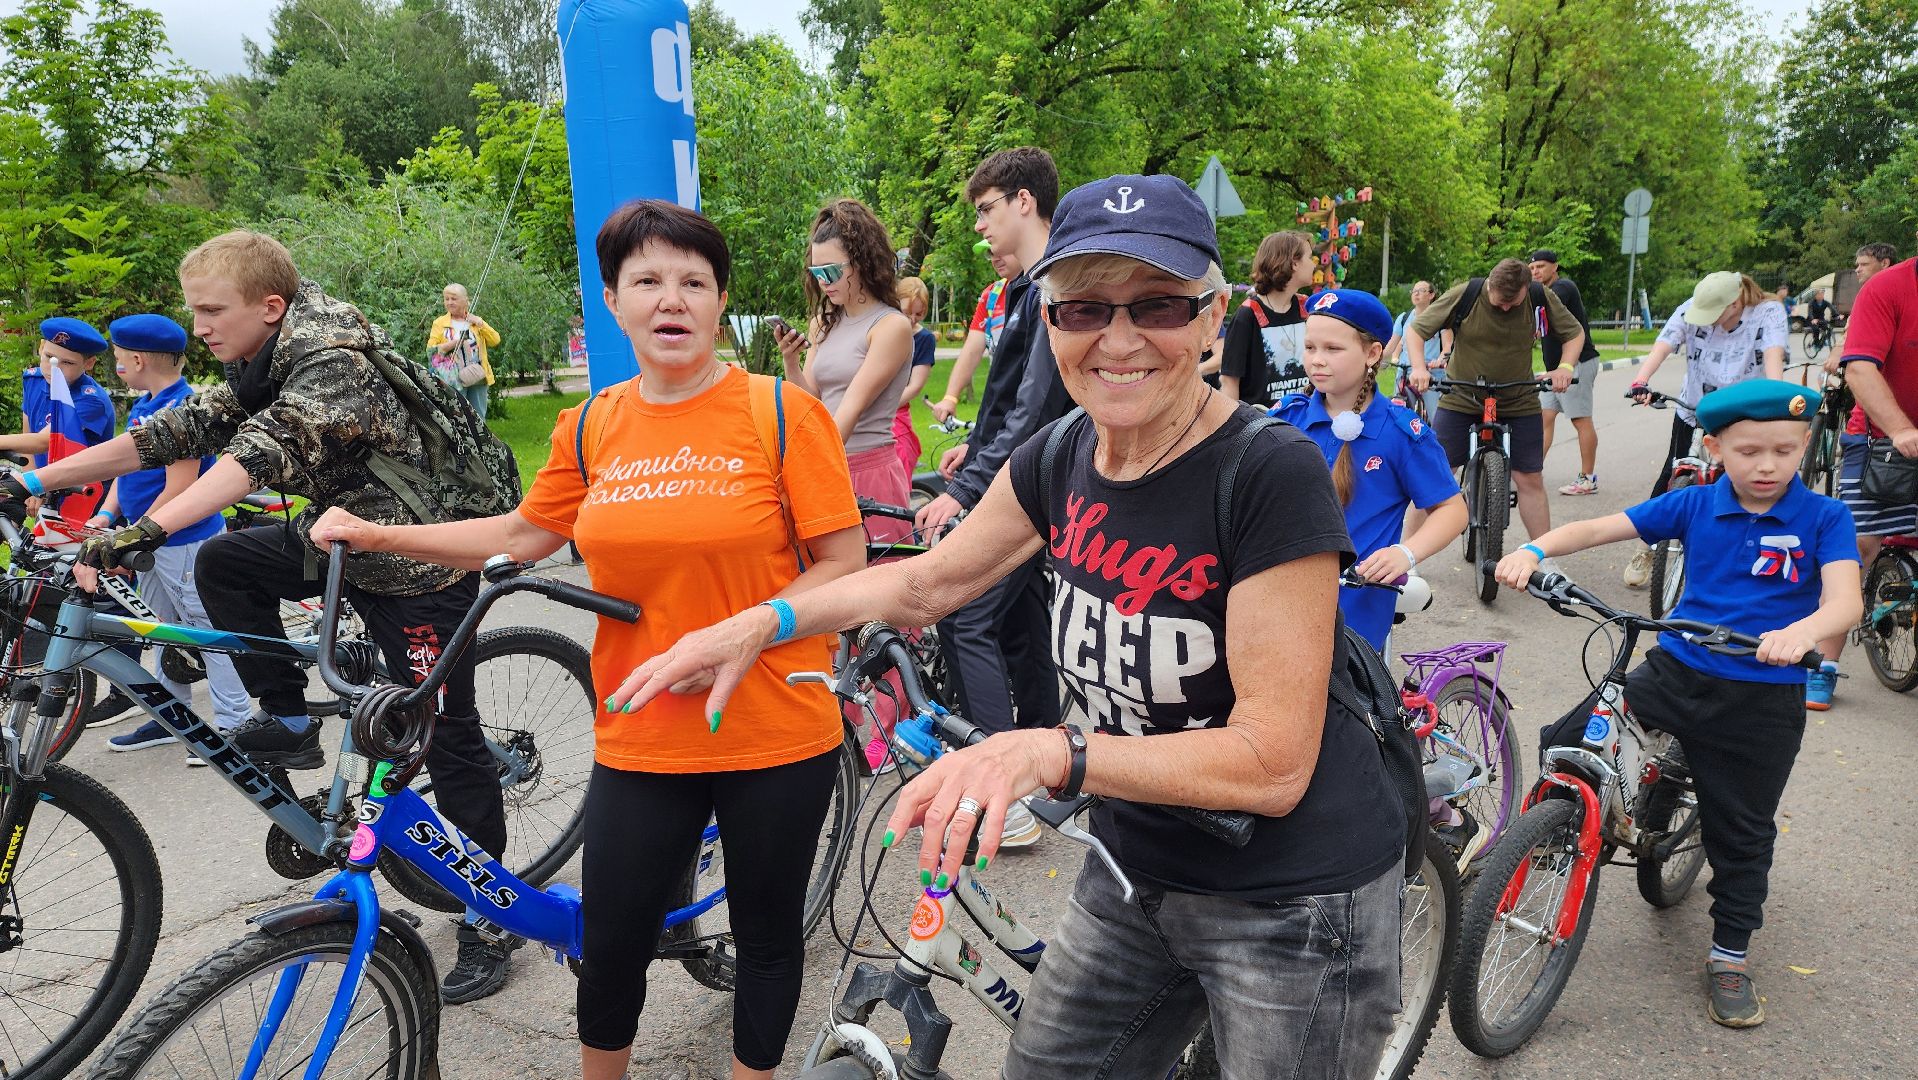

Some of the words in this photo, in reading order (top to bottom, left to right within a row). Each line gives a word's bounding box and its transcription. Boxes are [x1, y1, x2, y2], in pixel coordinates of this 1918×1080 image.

[1271, 379, 1298, 391] WANT
[1298, 377, 1309, 387] TO
[597, 445, 744, 482] Активное
[1050, 490, 1219, 616] Hugs
[127, 683, 292, 810] ASPECT
[404, 820, 519, 909] STELS
